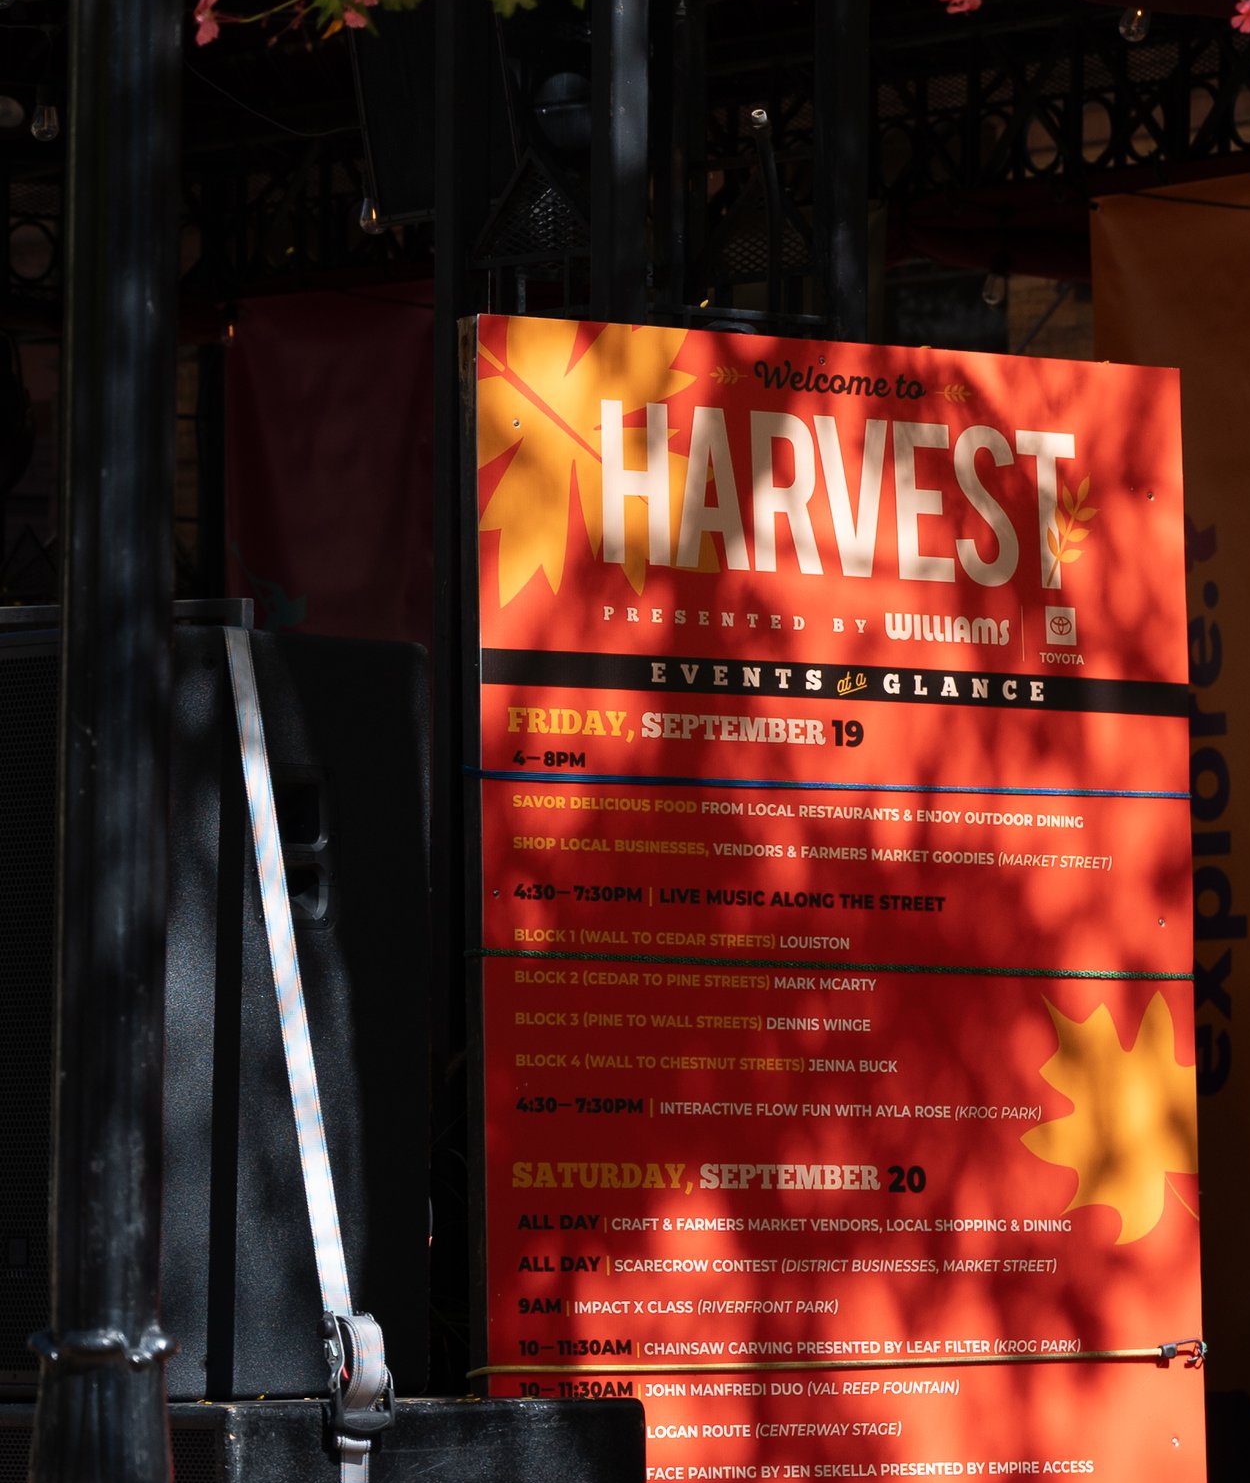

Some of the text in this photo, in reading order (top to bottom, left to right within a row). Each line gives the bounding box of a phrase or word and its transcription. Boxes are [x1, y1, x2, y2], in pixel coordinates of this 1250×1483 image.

[754, 360, 926, 400] Welcome to
[600, 399, 1075, 590] HARVEST
[603, 606, 805, 631] PRESENTED
[833, 618, 867, 634] BY
[1039, 652, 1084, 665] TOYOTA
[651, 662, 1044, 702] EVENTS at a GLANCE
[507, 707, 865, 747] FRIDAY, SEPTEMBER 19
[512, 794, 1084, 828] SAVOR DELICIOUS FOOD FROM LOCAL RESTAURANTS & ENJOY OUTDOOR DINING
[513, 836, 1112, 871] SHOP LOCAL BUSINESSES, VENDORS & FARMERS MARKET GOODIES (MARKET STREET)
[659, 888, 700, 904] LIVE
[706, 889, 765, 906] MUSIC
[770, 891, 834, 908] ALONG
[839, 893, 874, 910] THE
[879, 895, 945, 912] STREET
[514, 928, 849, 949] BLOCK 1 (WALL TO CEDAR STREETS) LOUISTON
[511, 1161, 927, 1196] SATURDAY, SEPTEMBER 20
[517, 1214, 1071, 1232] ALL DAY CRAFT & FARMERS MARKET VENDORS, LOCAL SHOPPING & DINING
[518, 1256, 1057, 1273] ALL DAY SCARECROW CONTEST (DISTRICT BUSINESSES, MARKET STREET)
[518, 1297, 838, 1314] 9AM IMPACT X CLASS (RIVERFRONT PARK)
[643, 1342, 724, 1355] CHAINSAW
[728, 1341, 793, 1354] CARVING
[797, 1341, 881, 1354] PRESENTED
[884, 1340, 903, 1355] BY
[906, 1340, 941, 1354] LEAF
[944, 1340, 990, 1354] FILTER
[994, 1338, 1037, 1355] (KROG
[1040, 1339, 1083, 1355] PARK)
[645, 1383, 686, 1397] JOHN
[690, 1383, 766, 1396] MANFREDI
[770, 1382, 803, 1395] DUO
[807, 1381, 839, 1396] (VAL
[842, 1381, 880, 1394] REEP
[883, 1379, 959, 1395] FOUNTAIN)
[646, 1421, 901, 1438] LOGAN ROUTE (CENTERWAY STAGE)
[646, 1460, 1094, 1480] FACE PAINTING BY JEN SEKELLA PRESENTED BY EMPIRE ACCESS
